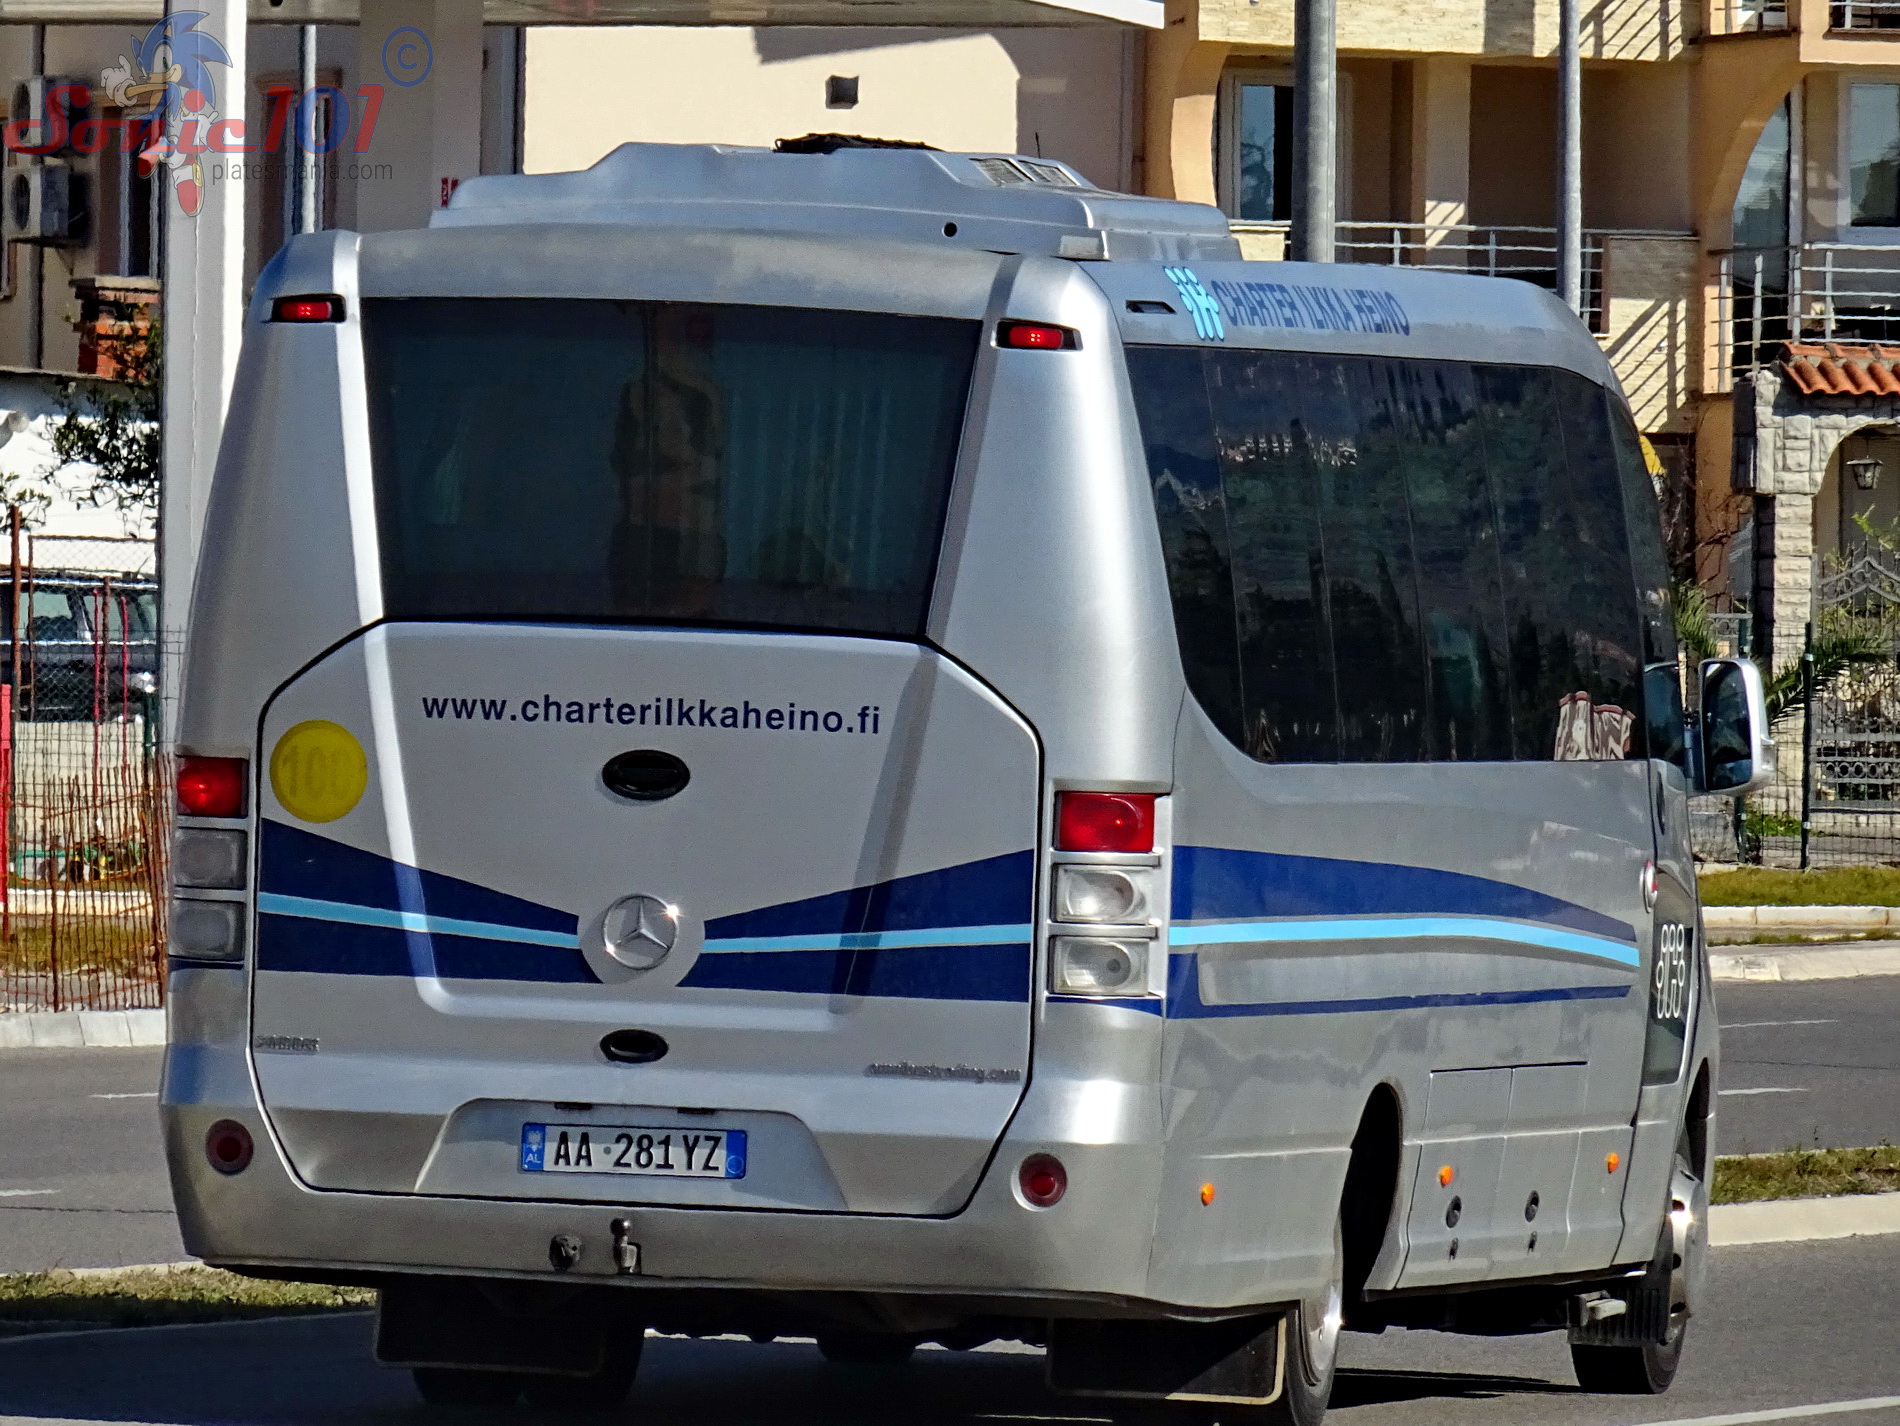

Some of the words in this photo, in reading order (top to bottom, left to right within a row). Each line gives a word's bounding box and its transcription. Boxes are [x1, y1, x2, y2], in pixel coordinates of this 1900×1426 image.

[1211, 280, 1306, 328] CHARTER
[1292, 285, 1357, 331] ILKKA
[1344, 288, 1410, 336] HEINO
[422, 694, 880, 735] www.charterilkkaheino.fi
[525, 1153, 541, 1164] AL
[554, 1130, 593, 1167] AA
[613, 1132, 675, 1170] 281
[682, 1134, 722, 1172] YZ
